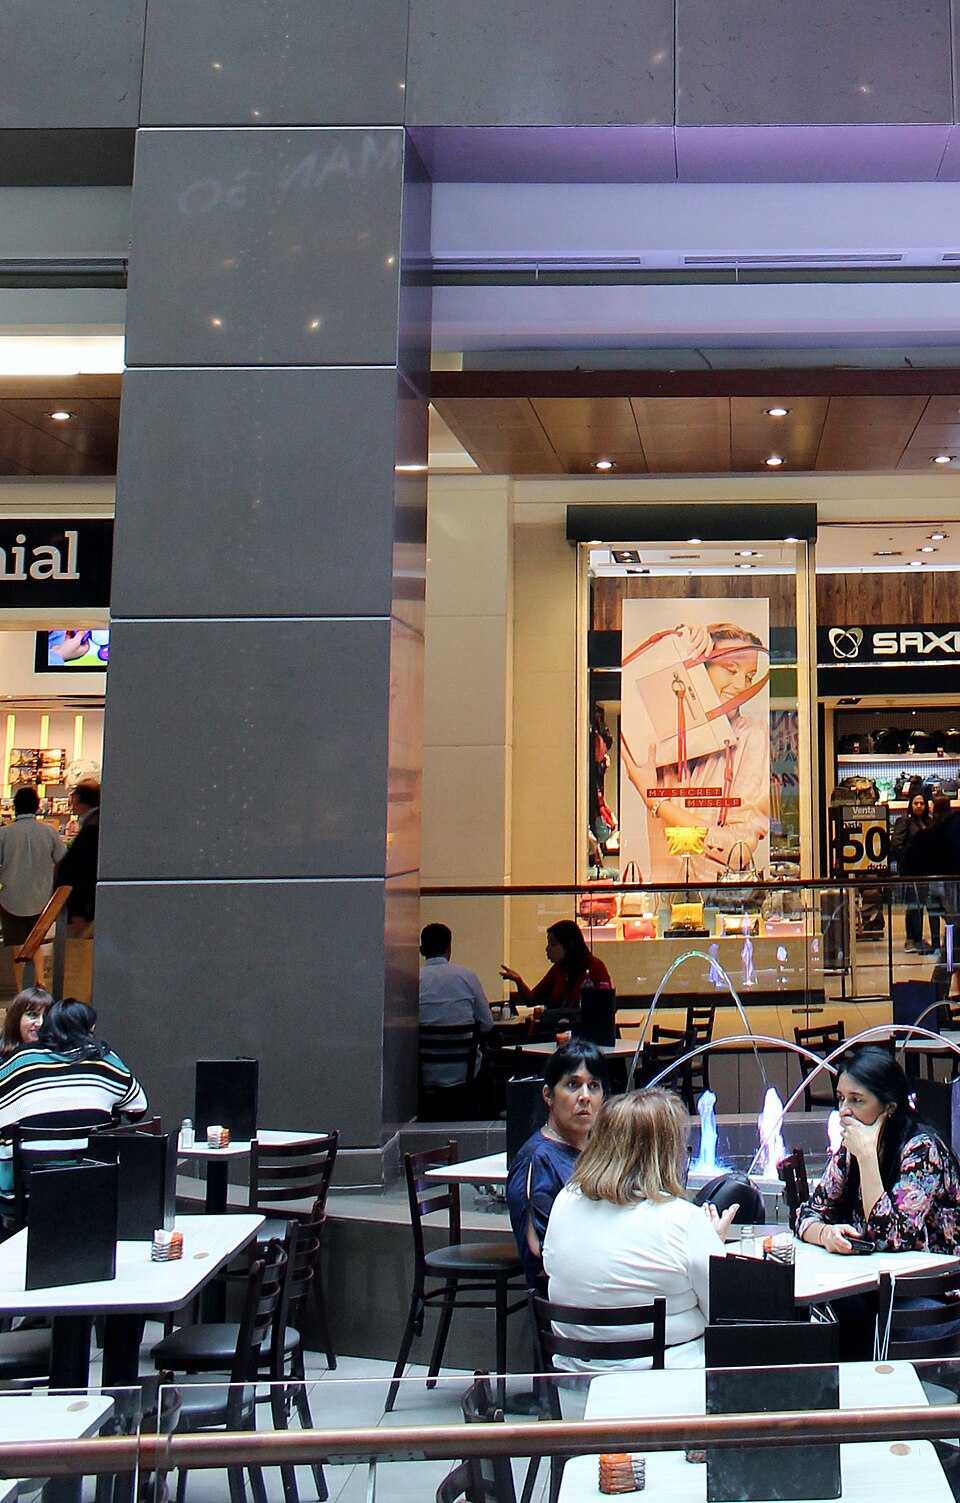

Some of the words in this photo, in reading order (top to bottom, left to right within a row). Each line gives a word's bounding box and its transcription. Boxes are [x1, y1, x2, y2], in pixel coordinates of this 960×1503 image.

[649, 789, 666, 797] MY
[671, 788, 721, 796] SECRET
[687, 799, 740, 807] MYSELF
[852, 806, 876, 815] Venta
[843, 825, 888, 864] 50
